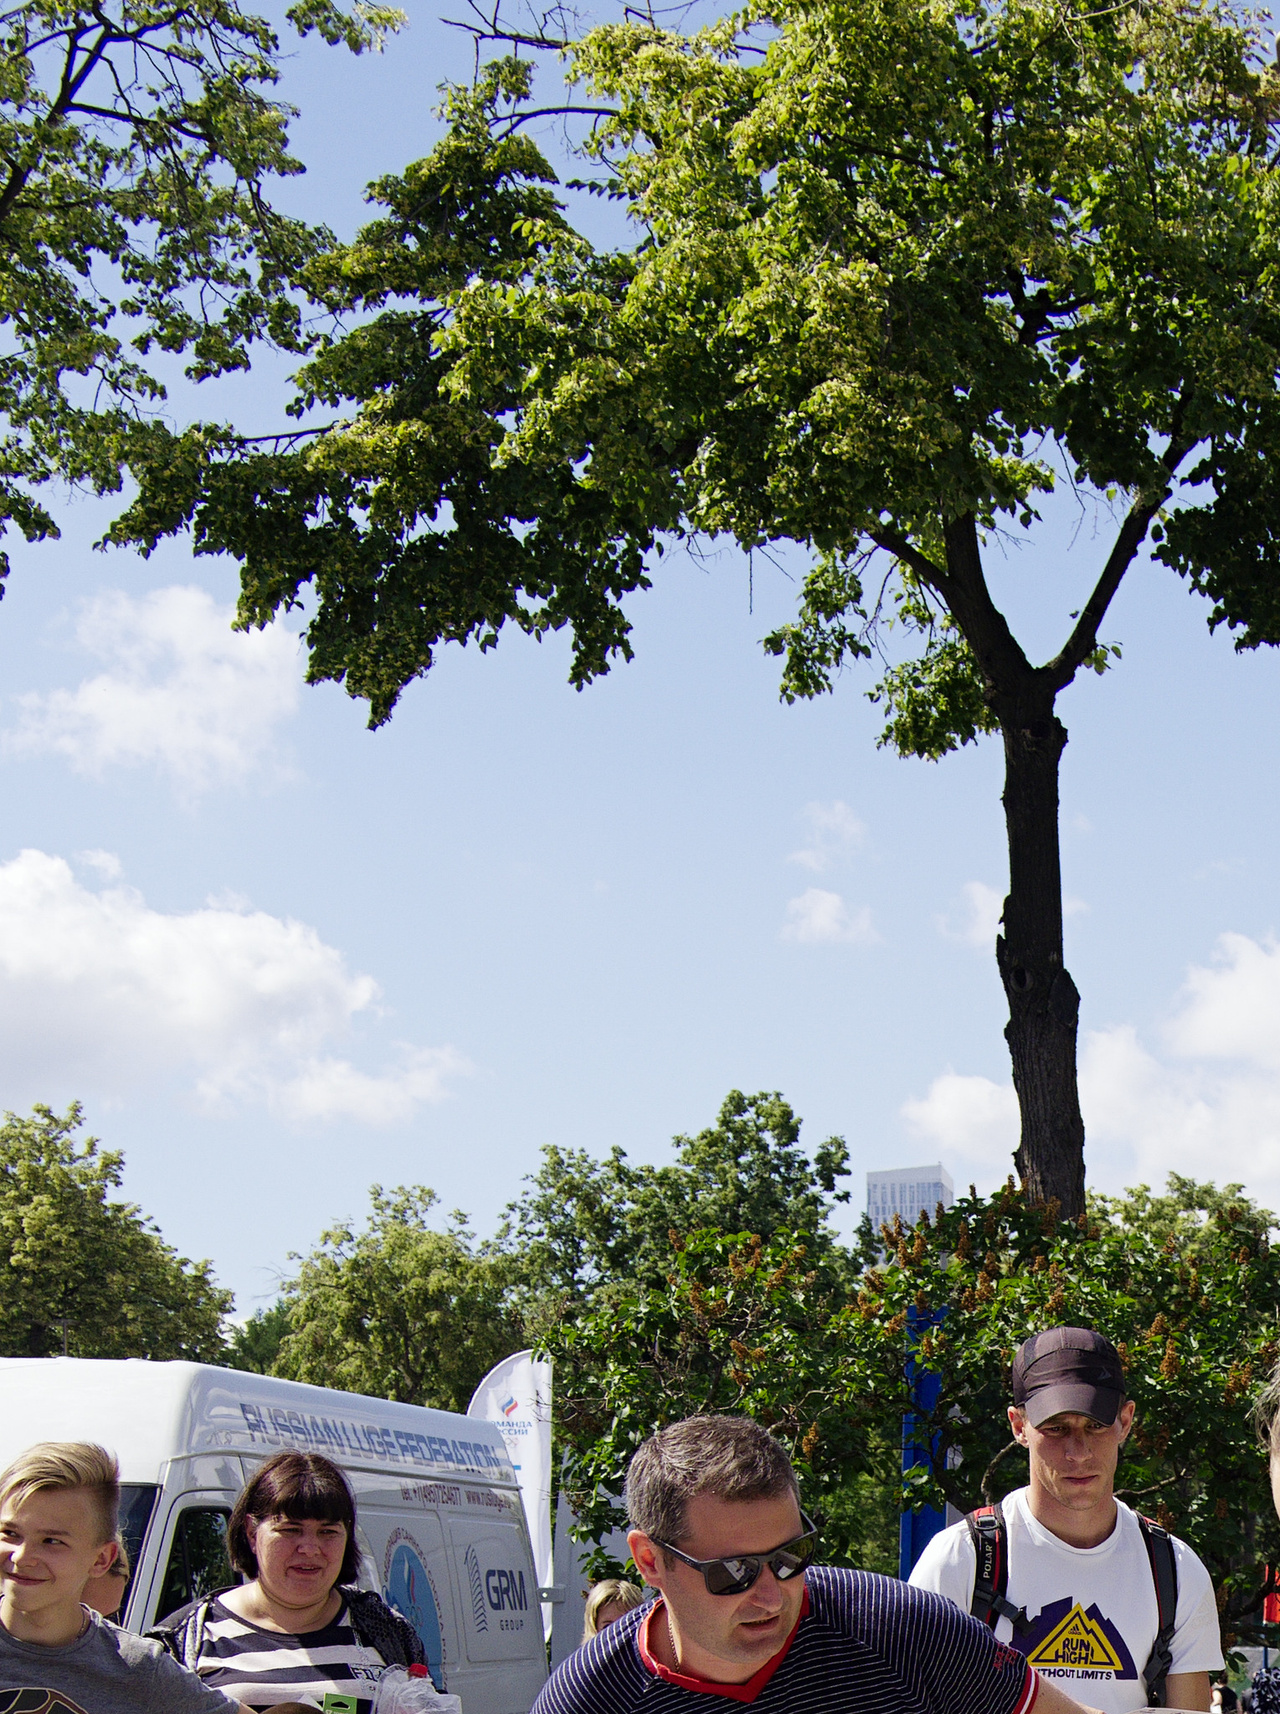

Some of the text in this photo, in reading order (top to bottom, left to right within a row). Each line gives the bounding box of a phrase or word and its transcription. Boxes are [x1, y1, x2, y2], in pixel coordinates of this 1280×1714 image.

[239, 1402, 501, 1472] RUSSIAN LUGE FEDERATION
[983, 1543, 993, 1579] POLAR
[485, 1569, 528, 1611] GRM
[500, 1619, 524, 1631] GROUP
[1062, 1638, 1092, 1653] RUN
[1037, 1667, 1113, 1680] THOUT LIMITS
